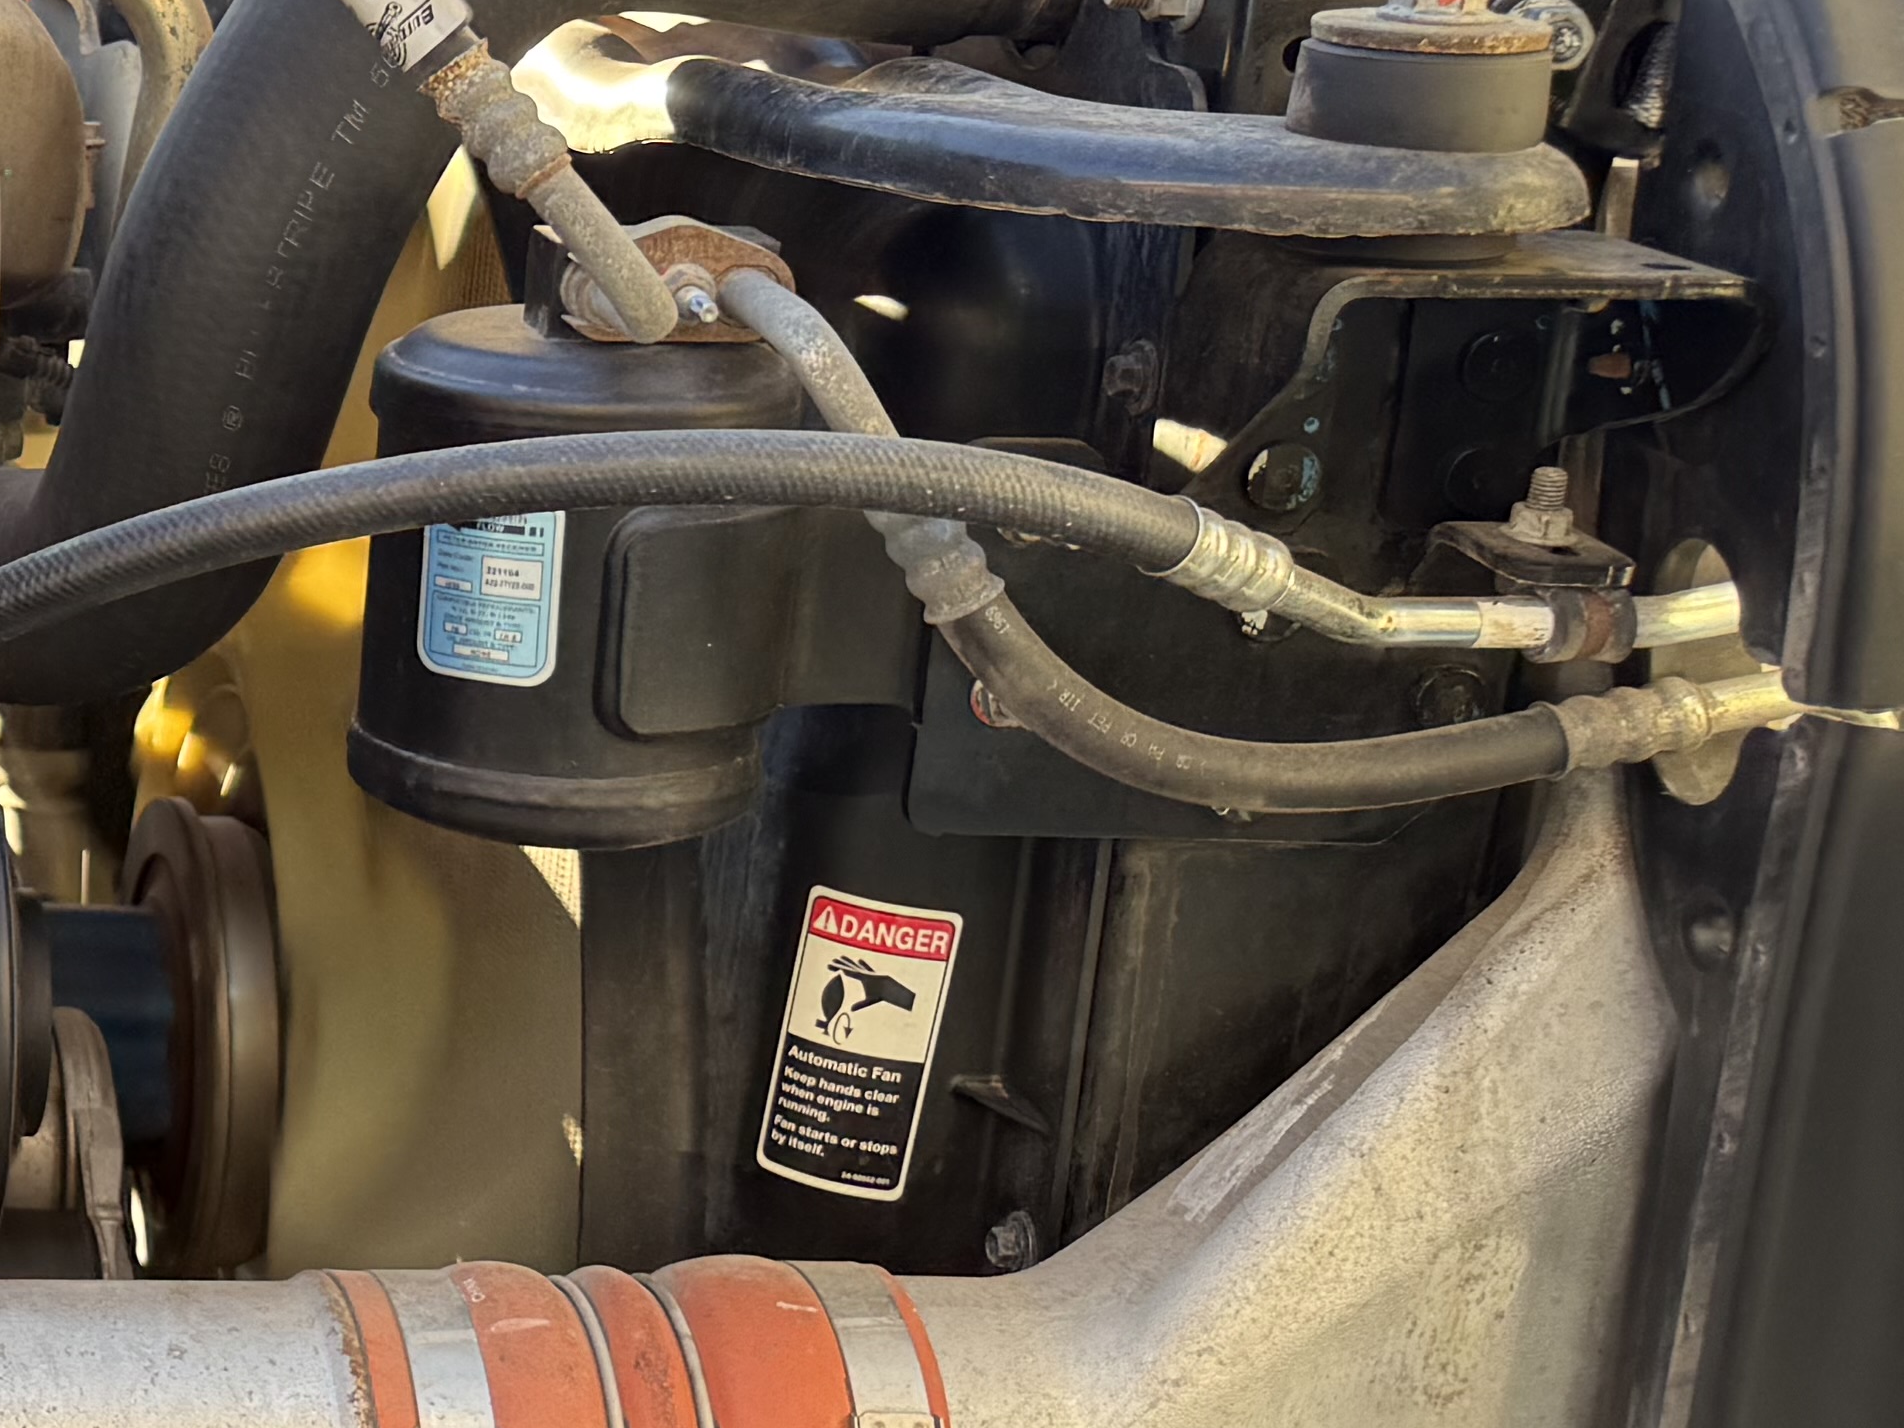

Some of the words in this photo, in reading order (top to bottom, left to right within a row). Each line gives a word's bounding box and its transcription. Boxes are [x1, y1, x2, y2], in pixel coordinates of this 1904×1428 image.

[840, 914, 949, 955] DANGER
[788, 1044, 868, 1078] Automatic
[871, 1066, 902, 1084] Fan
[781, 1082, 814, 1101] when
[816, 1094, 864, 1114] engine
[866, 1103, 880, 1117] is
[784, 1065, 817, 1087] Keep
[818, 1077, 862, 1098] hands
[864, 1089, 900, 1104] clear
[778, 1096, 831, 1123] running.
[771, 1128, 787, 1145] by
[788, 1136, 825, 1157] itself.
[774, 1114, 796, 1132] Fan
[798, 1124, 839, 1145] starts
[840, 1137, 858, 1149] or
[859, 1140, 898, 1156] stops
